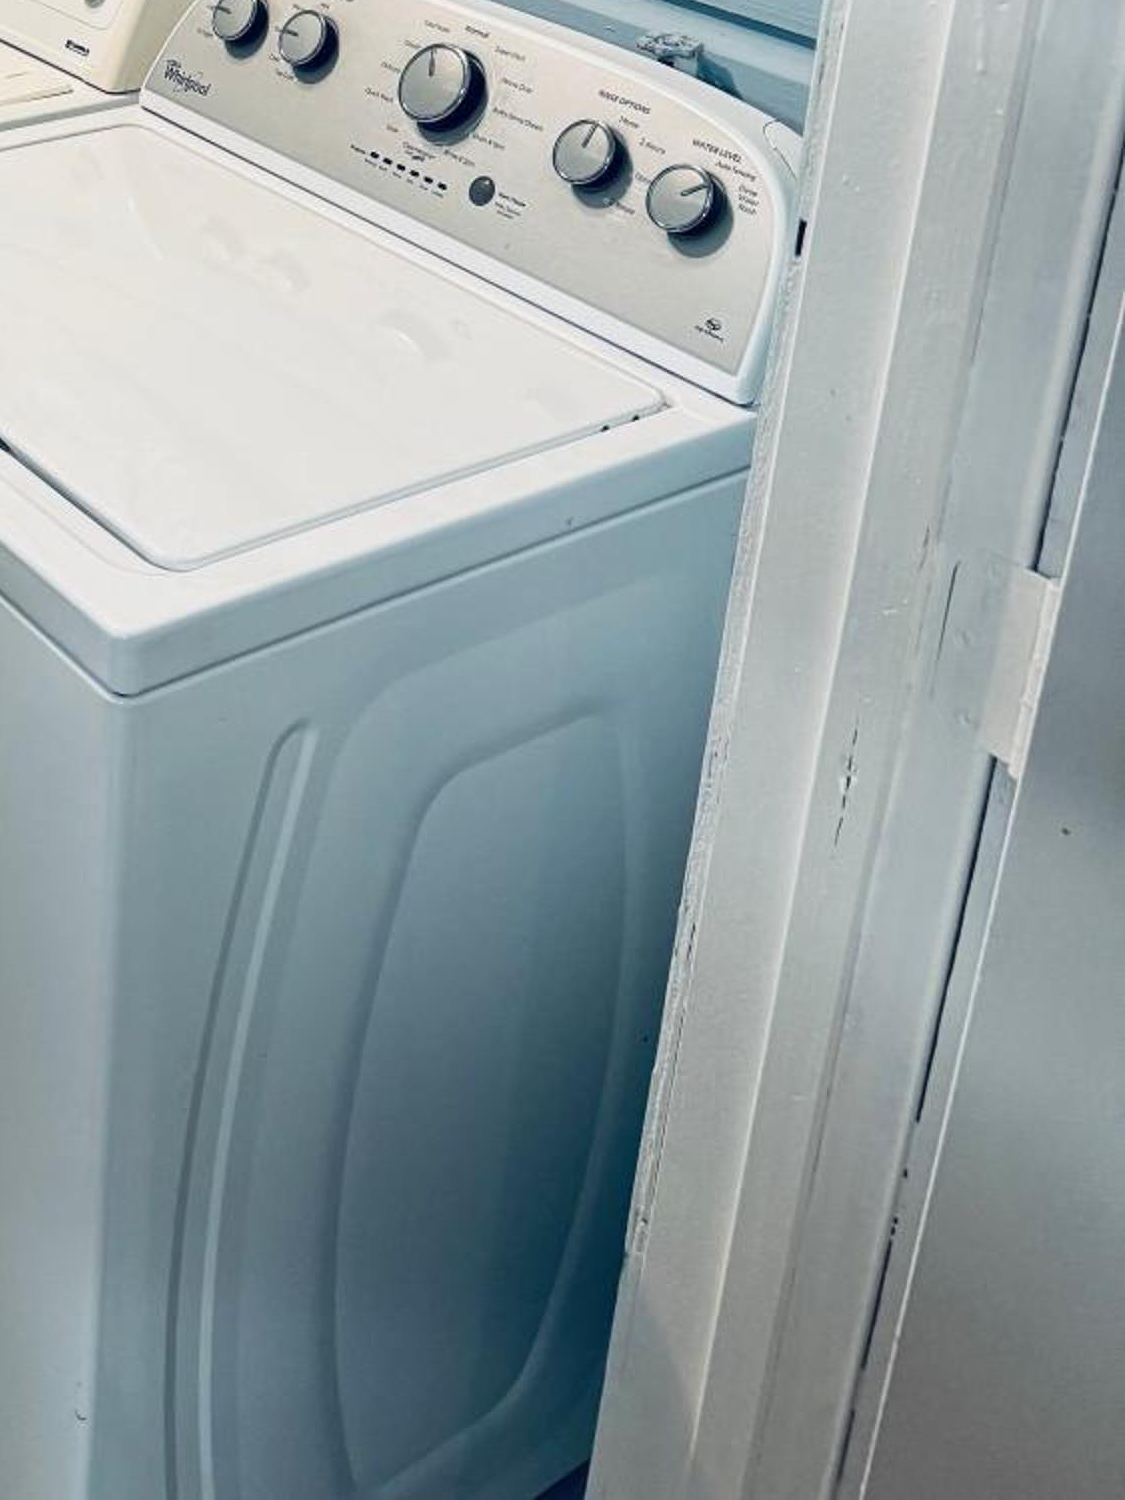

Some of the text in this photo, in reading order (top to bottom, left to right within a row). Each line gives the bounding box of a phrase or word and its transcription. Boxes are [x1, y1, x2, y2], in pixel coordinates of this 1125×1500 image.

[164, 66, 212, 97] Whirlpool
[619, 96, 651, 115] OPTIONS
[692, 138, 742, 163] WATER LEVEL
